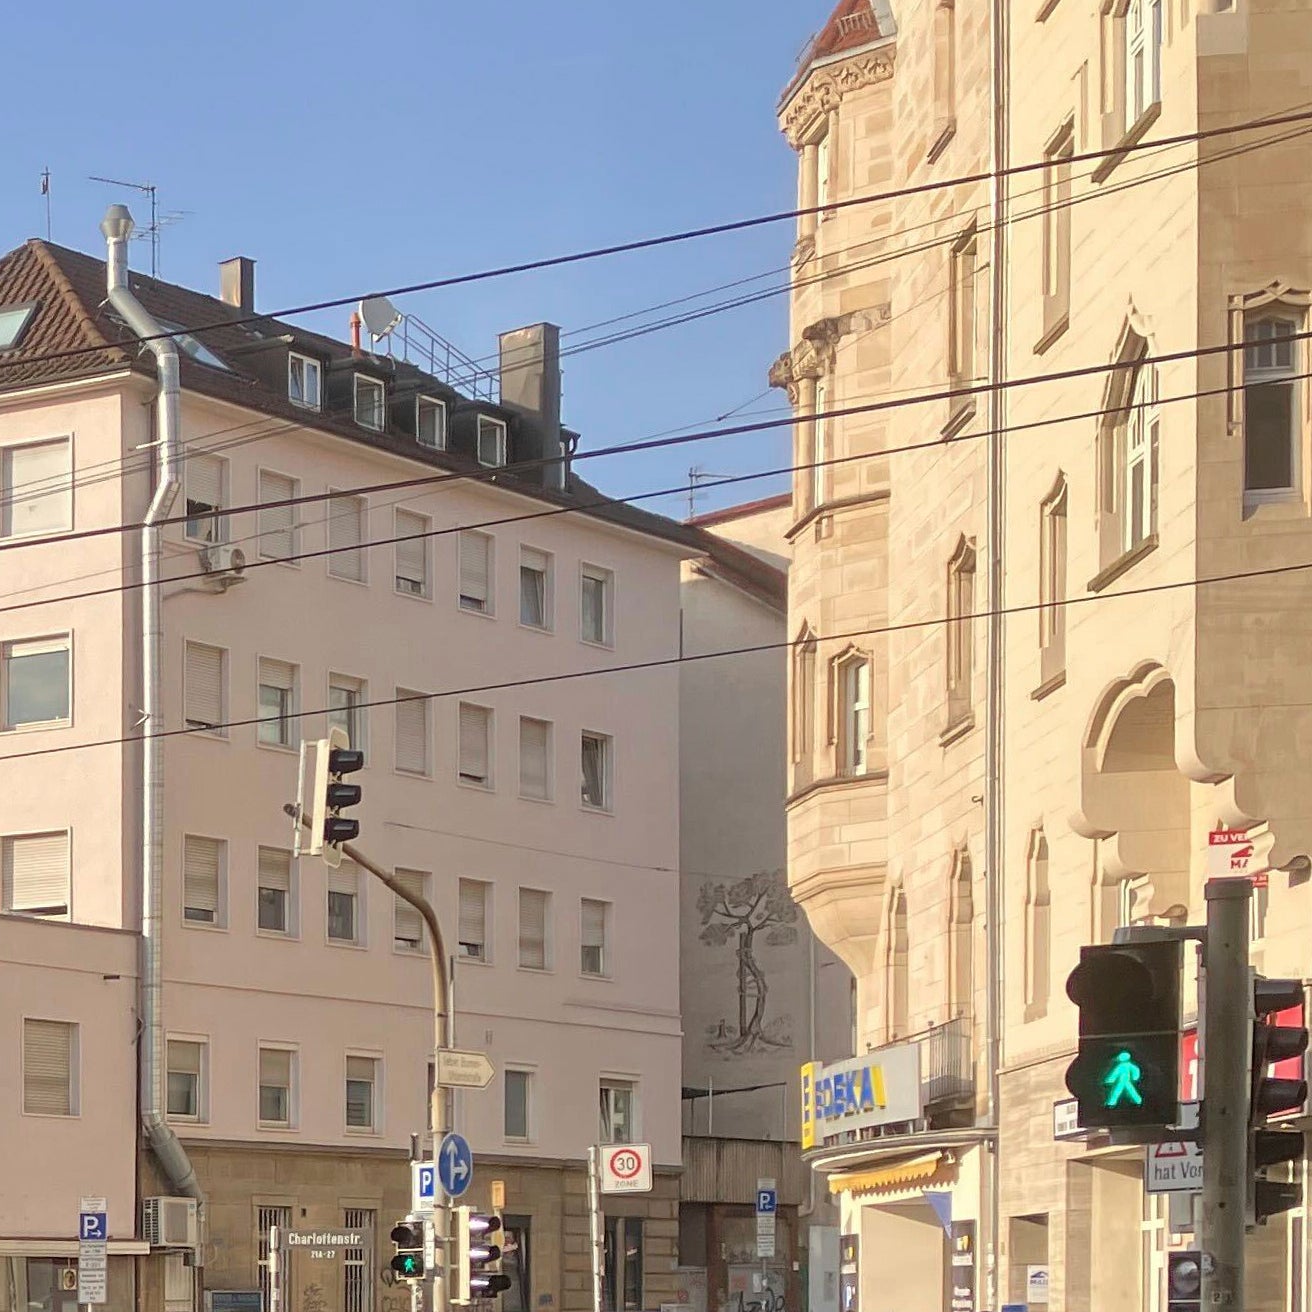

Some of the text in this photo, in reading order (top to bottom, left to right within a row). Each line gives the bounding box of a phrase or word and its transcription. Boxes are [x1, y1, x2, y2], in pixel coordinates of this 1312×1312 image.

[814, 1065, 876, 1119] EDEKA
[616, 1156, 636, 1171] 30
[1154, 1161, 1177, 1180] hat
[422, 1170, 432, 1194] P
[759, 1192, 770, 1210] P
[83, 1215, 99, 1238] P
[288, 1232, 364, 1246] Charlottenstr.
